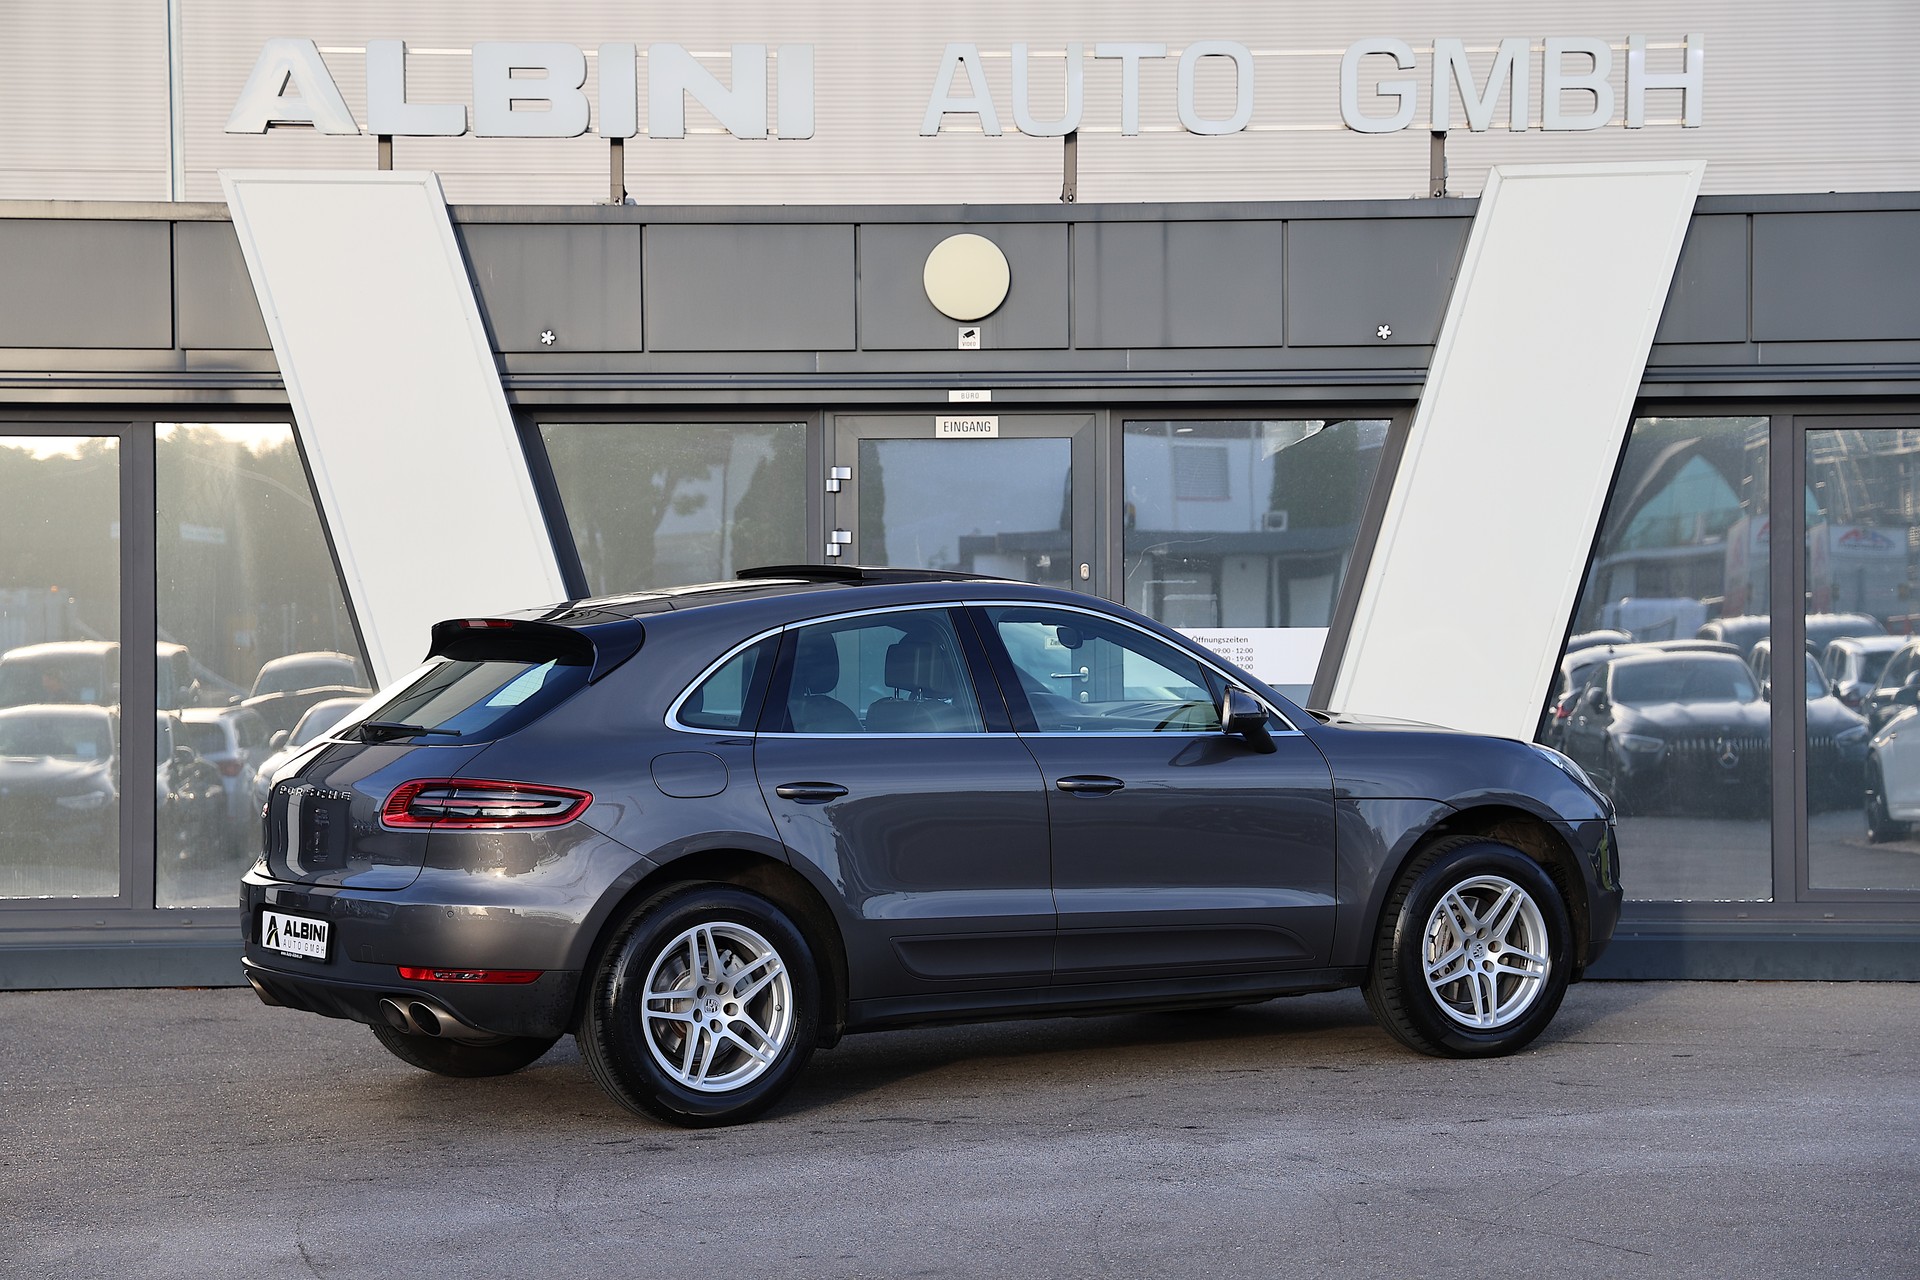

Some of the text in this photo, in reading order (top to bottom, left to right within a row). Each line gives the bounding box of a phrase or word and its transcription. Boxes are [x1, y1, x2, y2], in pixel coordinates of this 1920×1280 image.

[225, 32, 1706, 140] ALBINI AUTO GMBH
[943, 421, 991, 432] EINGANG
[280, 785, 351, 800] PORSCHE
[283, 919, 326, 943] ALBINI
[282, 939, 325, 954] AUTO GMBH
